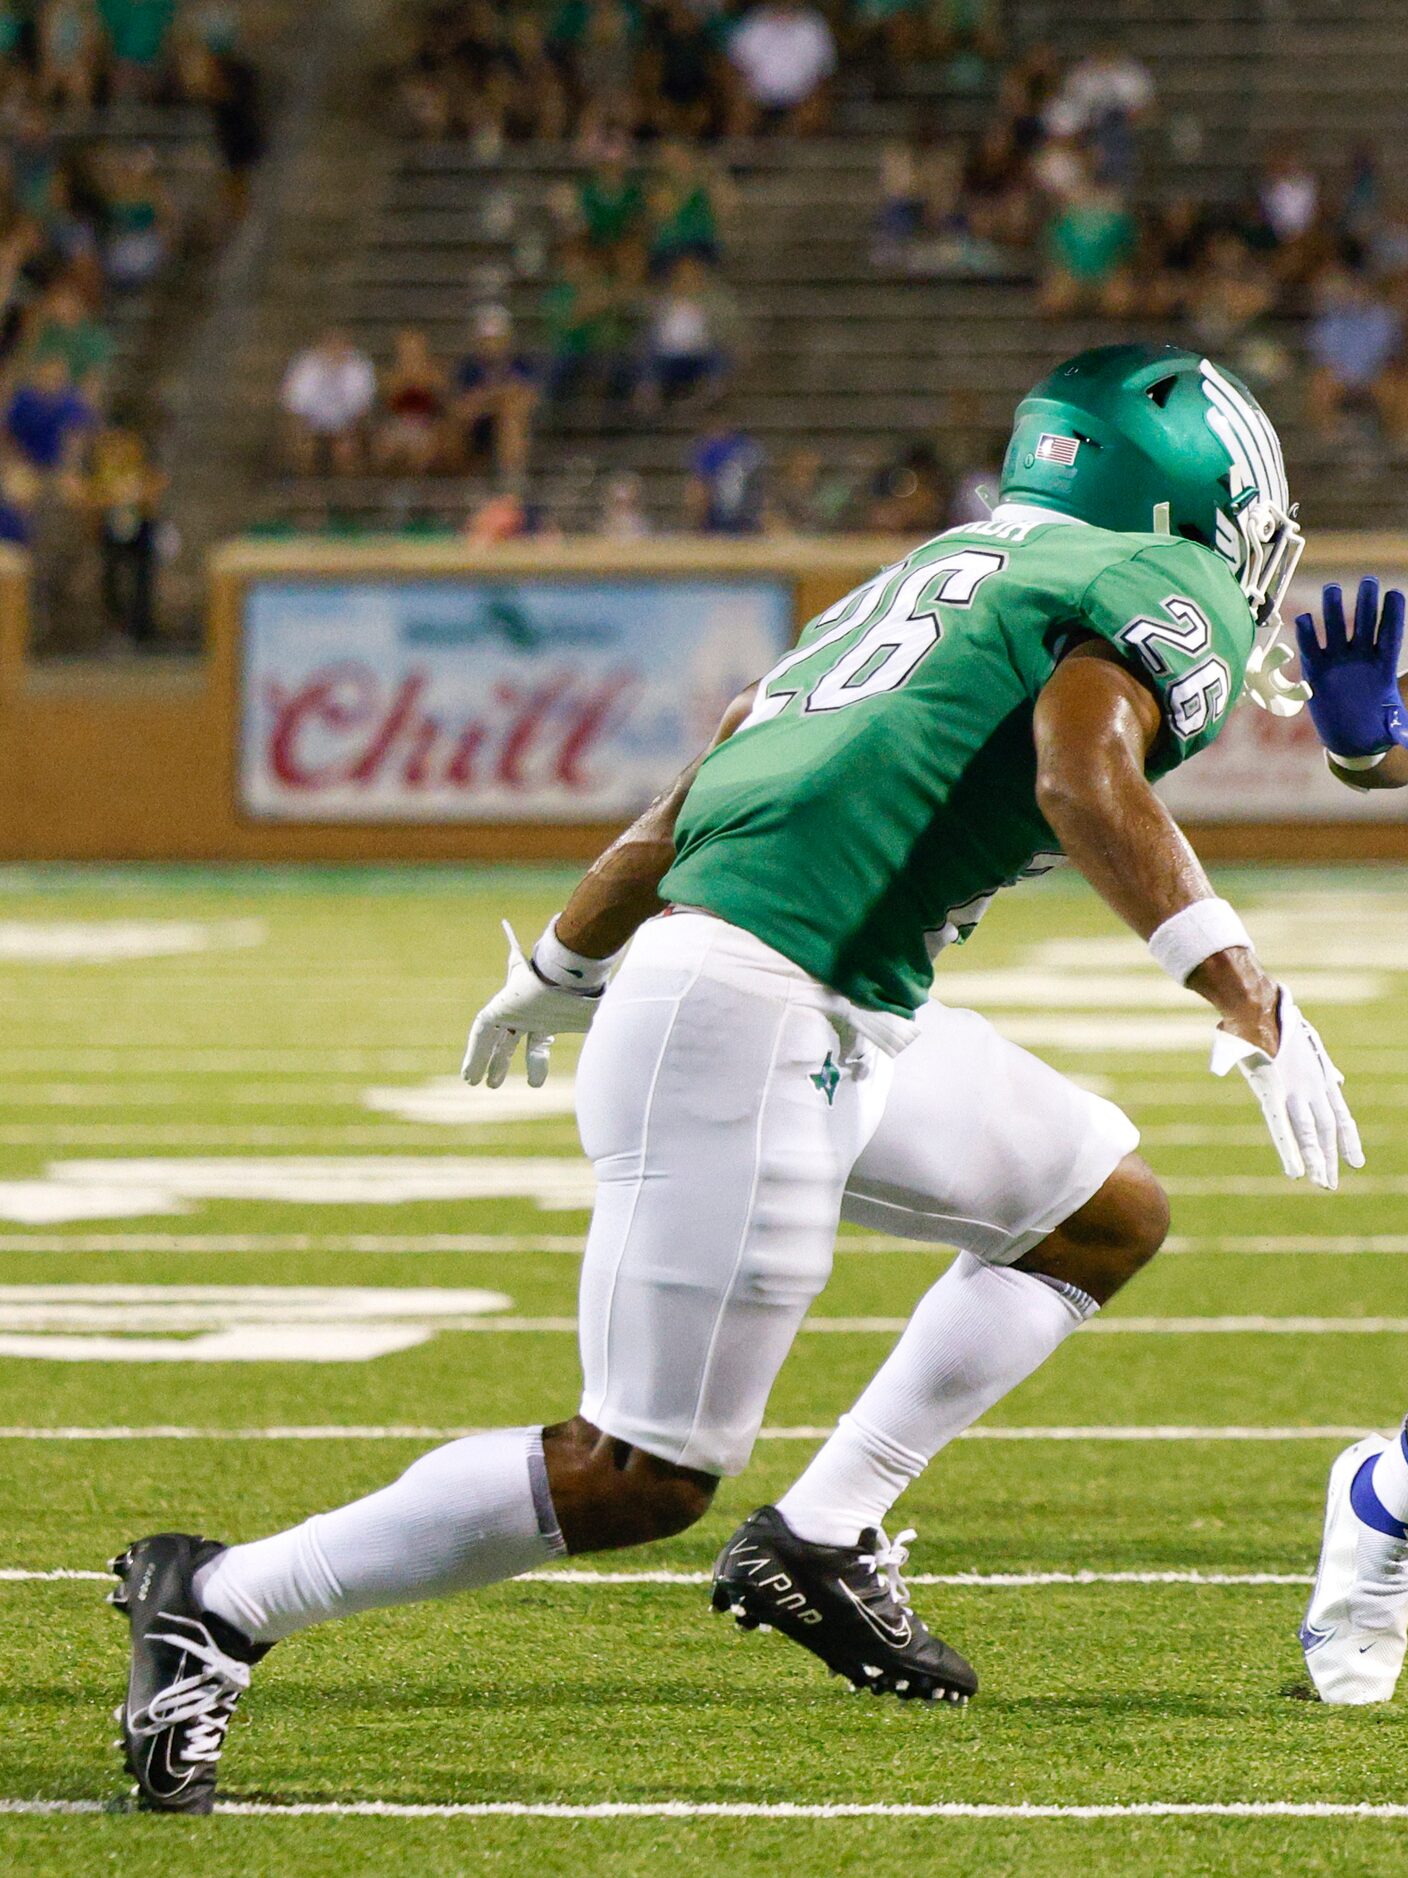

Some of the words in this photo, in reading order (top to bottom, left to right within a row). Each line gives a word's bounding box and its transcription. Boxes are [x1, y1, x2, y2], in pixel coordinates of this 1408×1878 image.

[733, 548, 1010, 735] 26
[1114, 593, 1231, 741] 26
[266, 658, 641, 789] Chill
